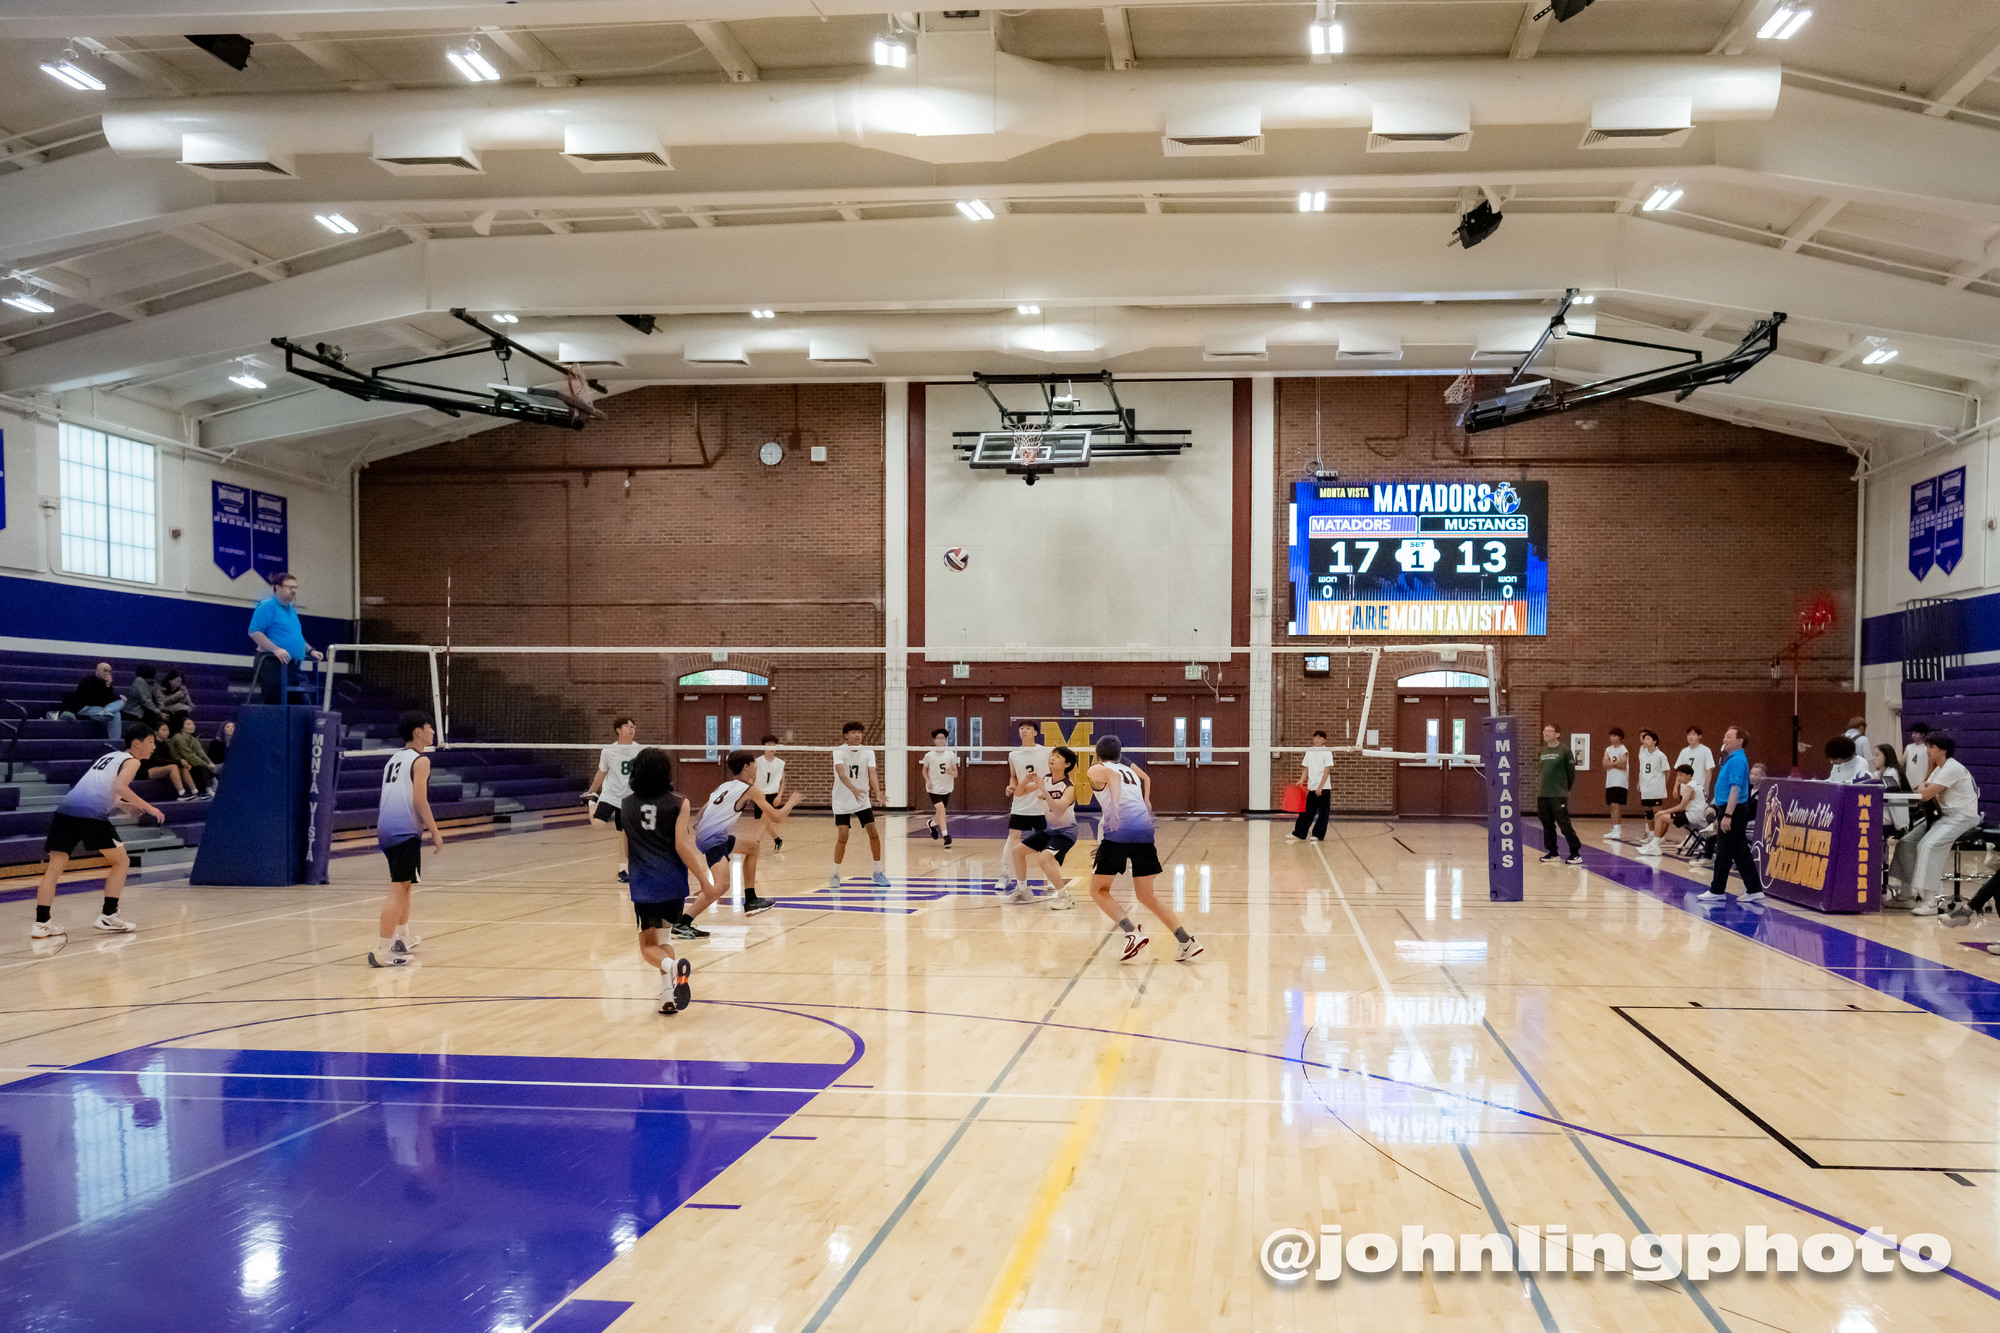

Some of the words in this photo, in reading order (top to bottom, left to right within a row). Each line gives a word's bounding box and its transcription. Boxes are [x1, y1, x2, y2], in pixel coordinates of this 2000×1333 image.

[1320, 487, 1345, 498] MONTA
[1347, 487, 1369, 498] VISTA
[1373, 484, 1491, 513] MATADORS
[1311, 518, 1392, 531] MATADORS
[1444, 518, 1525, 531] MUSTANGS
[1329, 541, 1380, 573] 17
[1411, 551, 1425, 568] 1
[1456, 541, 1507, 573] 13
[1322, 584, 1333, 599] 0
[1502, 584, 1513, 599] 0
[309, 733, 324, 794] MONTA
[621, 760, 632, 775] 8
[1911, 753, 1918, 765] 4
[385, 761, 402, 783] 13
[939, 763, 946, 774] 5
[1645, 763, 1652, 774] 9
[1119, 769, 1138, 786] 11
[1495, 739, 1514, 868] MATADORS
[640, 804, 658, 831] 3
[1785, 798, 1809, 824] Home
[1808, 802, 1822, 827] of
[306, 802, 318, 862] VISTA
[1857, 794, 1872, 903] MATADORS
